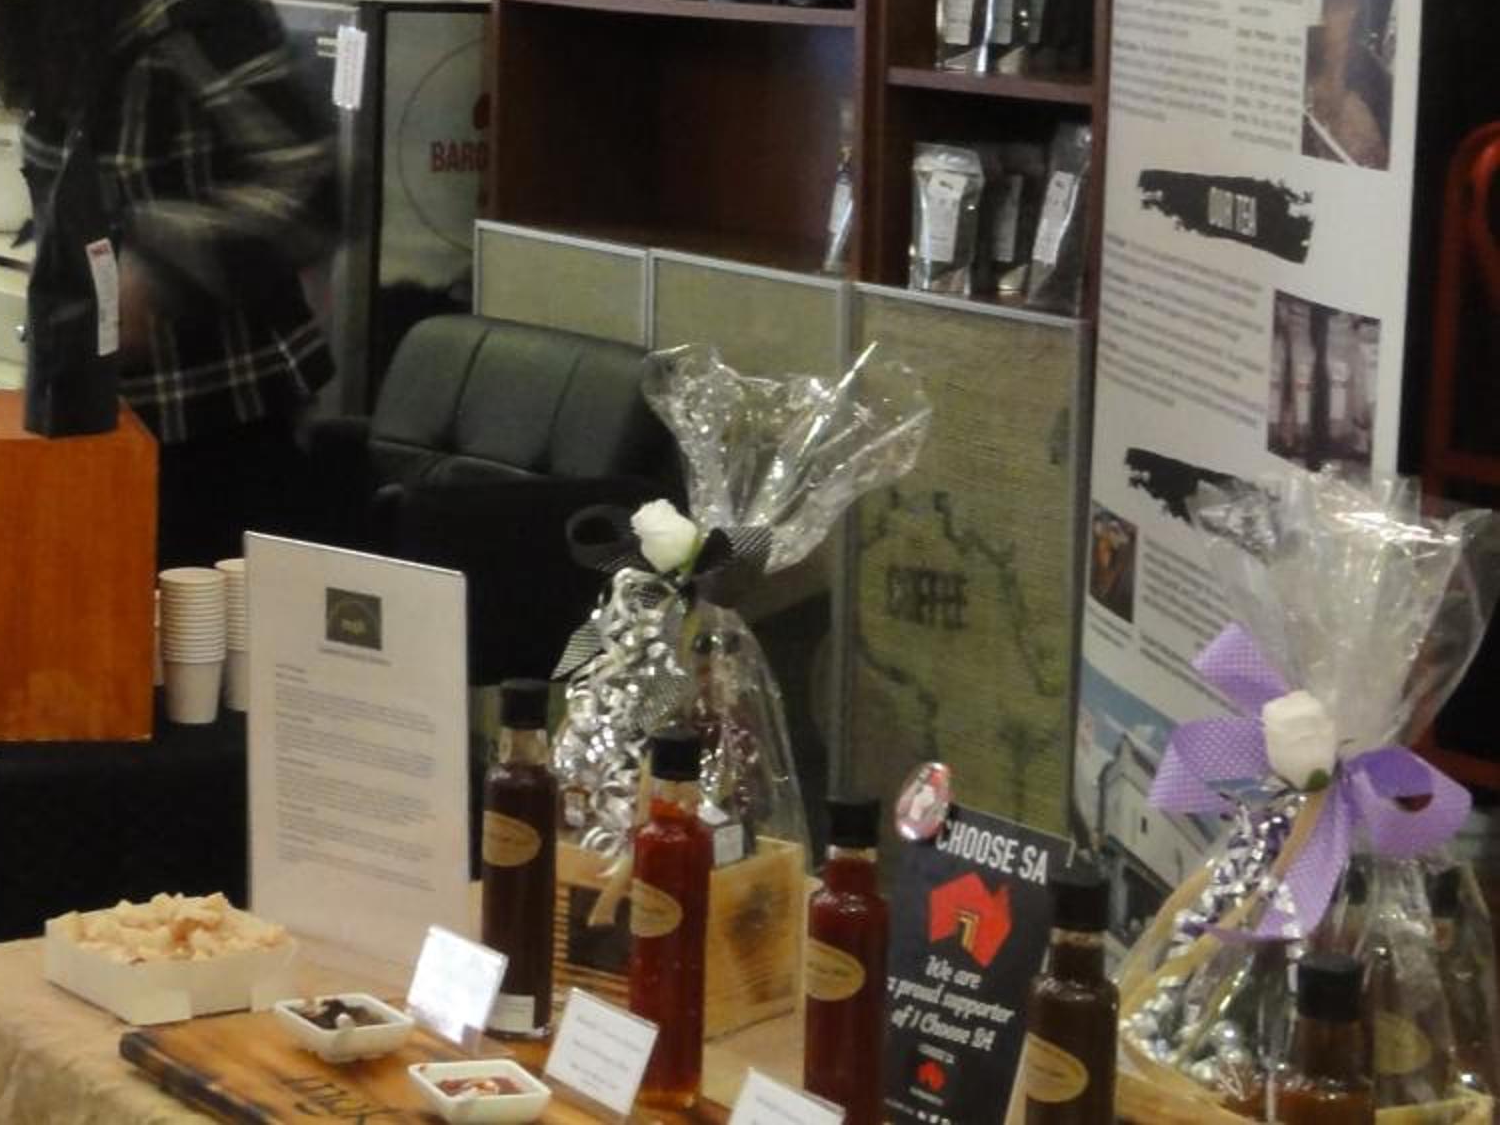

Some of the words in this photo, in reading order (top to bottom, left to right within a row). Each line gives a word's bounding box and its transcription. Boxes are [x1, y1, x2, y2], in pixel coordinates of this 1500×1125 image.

[937, 819, 1019, 874] CHOOSE
[1018, 844, 1049, 886] SA
[893, 979, 945, 1004] proud
[942, 992, 1016, 1024] supporter
[891, 1004, 914, 1029] of
[970, 1026, 997, 1052] SA
